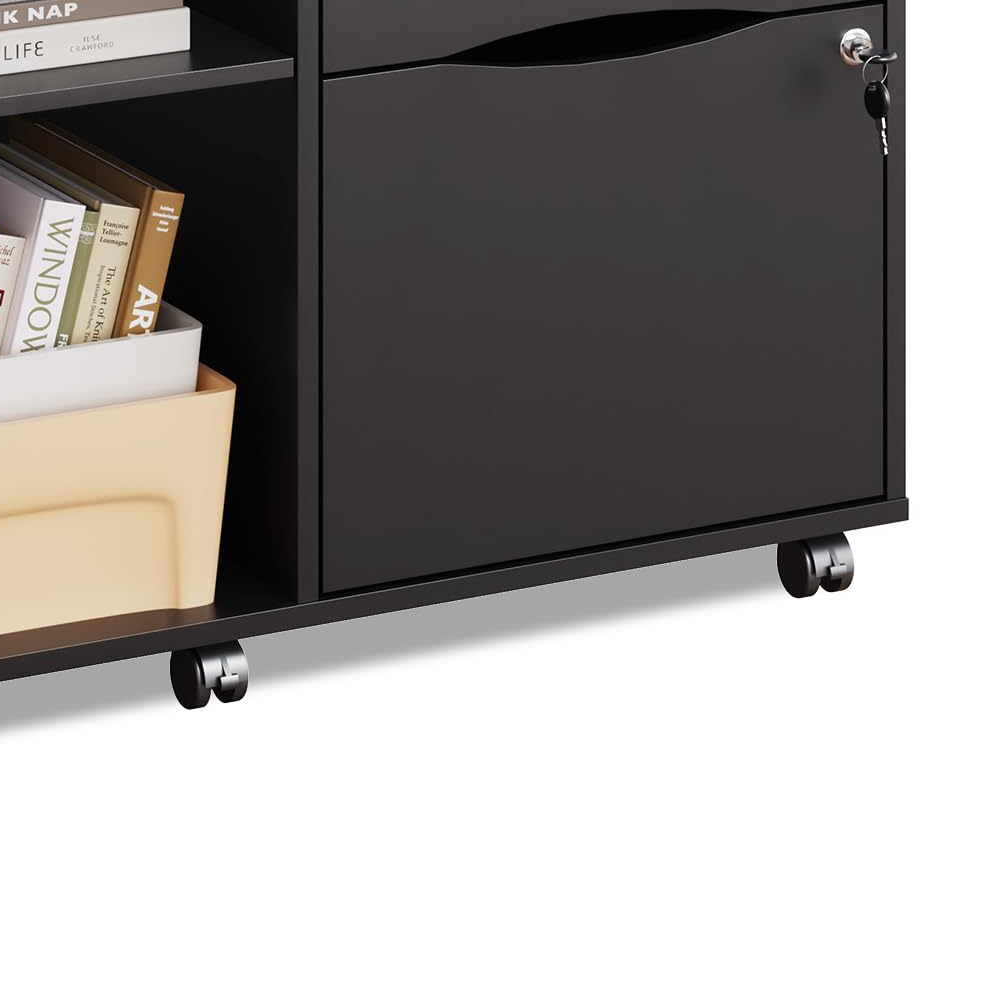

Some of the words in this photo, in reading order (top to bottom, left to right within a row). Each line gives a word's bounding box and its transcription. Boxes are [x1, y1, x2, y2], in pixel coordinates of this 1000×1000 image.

[28, 2, 78, 22] NAP
[69, 41, 114, 53] CRAWFORD
[83, 34, 101, 43] ILSE
[4, 40, 44, 61] LIFE
[99, 236, 129, 247] Loumagne
[105, 266, 117, 286] The
[101, 287, 111, 306] Art
[97, 307, 105, 321] of
[128, 284, 158, 334] AR
